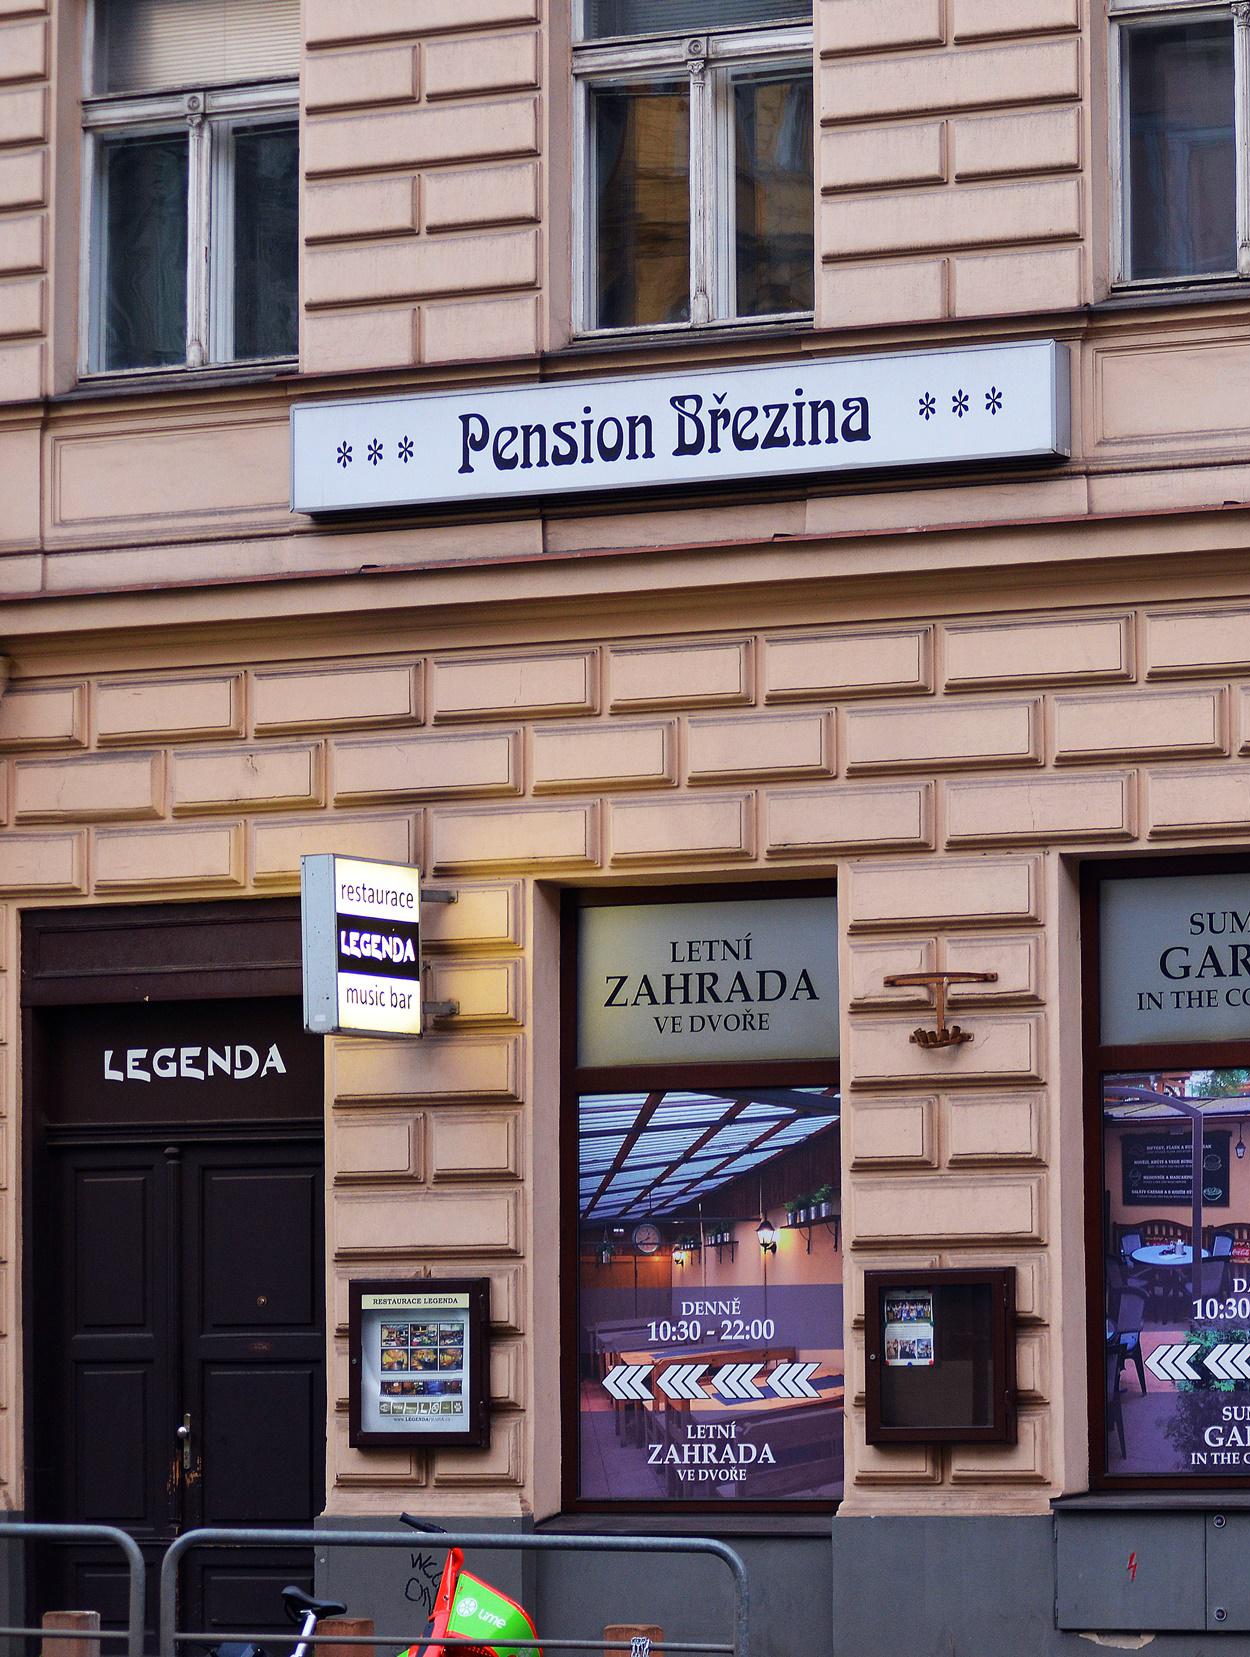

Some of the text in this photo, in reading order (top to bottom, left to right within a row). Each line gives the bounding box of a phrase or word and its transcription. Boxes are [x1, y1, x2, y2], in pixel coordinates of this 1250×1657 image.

[458, 387, 871, 475] Pension Březina
[341, 882, 415, 909] restaurace
[340, 930, 416, 964] LEGENDA
[669, 932, 753, 963] LETNÍ
[346, 984, 413, 1010] music bar
[603, 968, 820, 1008] ZAHRADA
[1136, 991, 1164, 1011] IN
[1170, 989, 1219, 1009] THE
[653, 1008, 770, 1035] VE DVOŘE
[104, 1043, 287, 1083] LEGENDA
[681, 1297, 741, 1316] DENNĚ
[1192, 1297, 1250, 1321] 10:30
[647, 1320, 701, 1342] 10:30
[720, 1319, 775, 1341] 22:00
[687, 1420, 737, 1439] LETNÍ
[647, 1442, 777, 1465] ZAHRADA
[1191, 1452, 1212, 1465] IN
[1213, 1452, 1241, 1465] THE
[677, 1465, 747, 1482] VE DVOŘE
[478, 1608, 507, 1629] Lime
